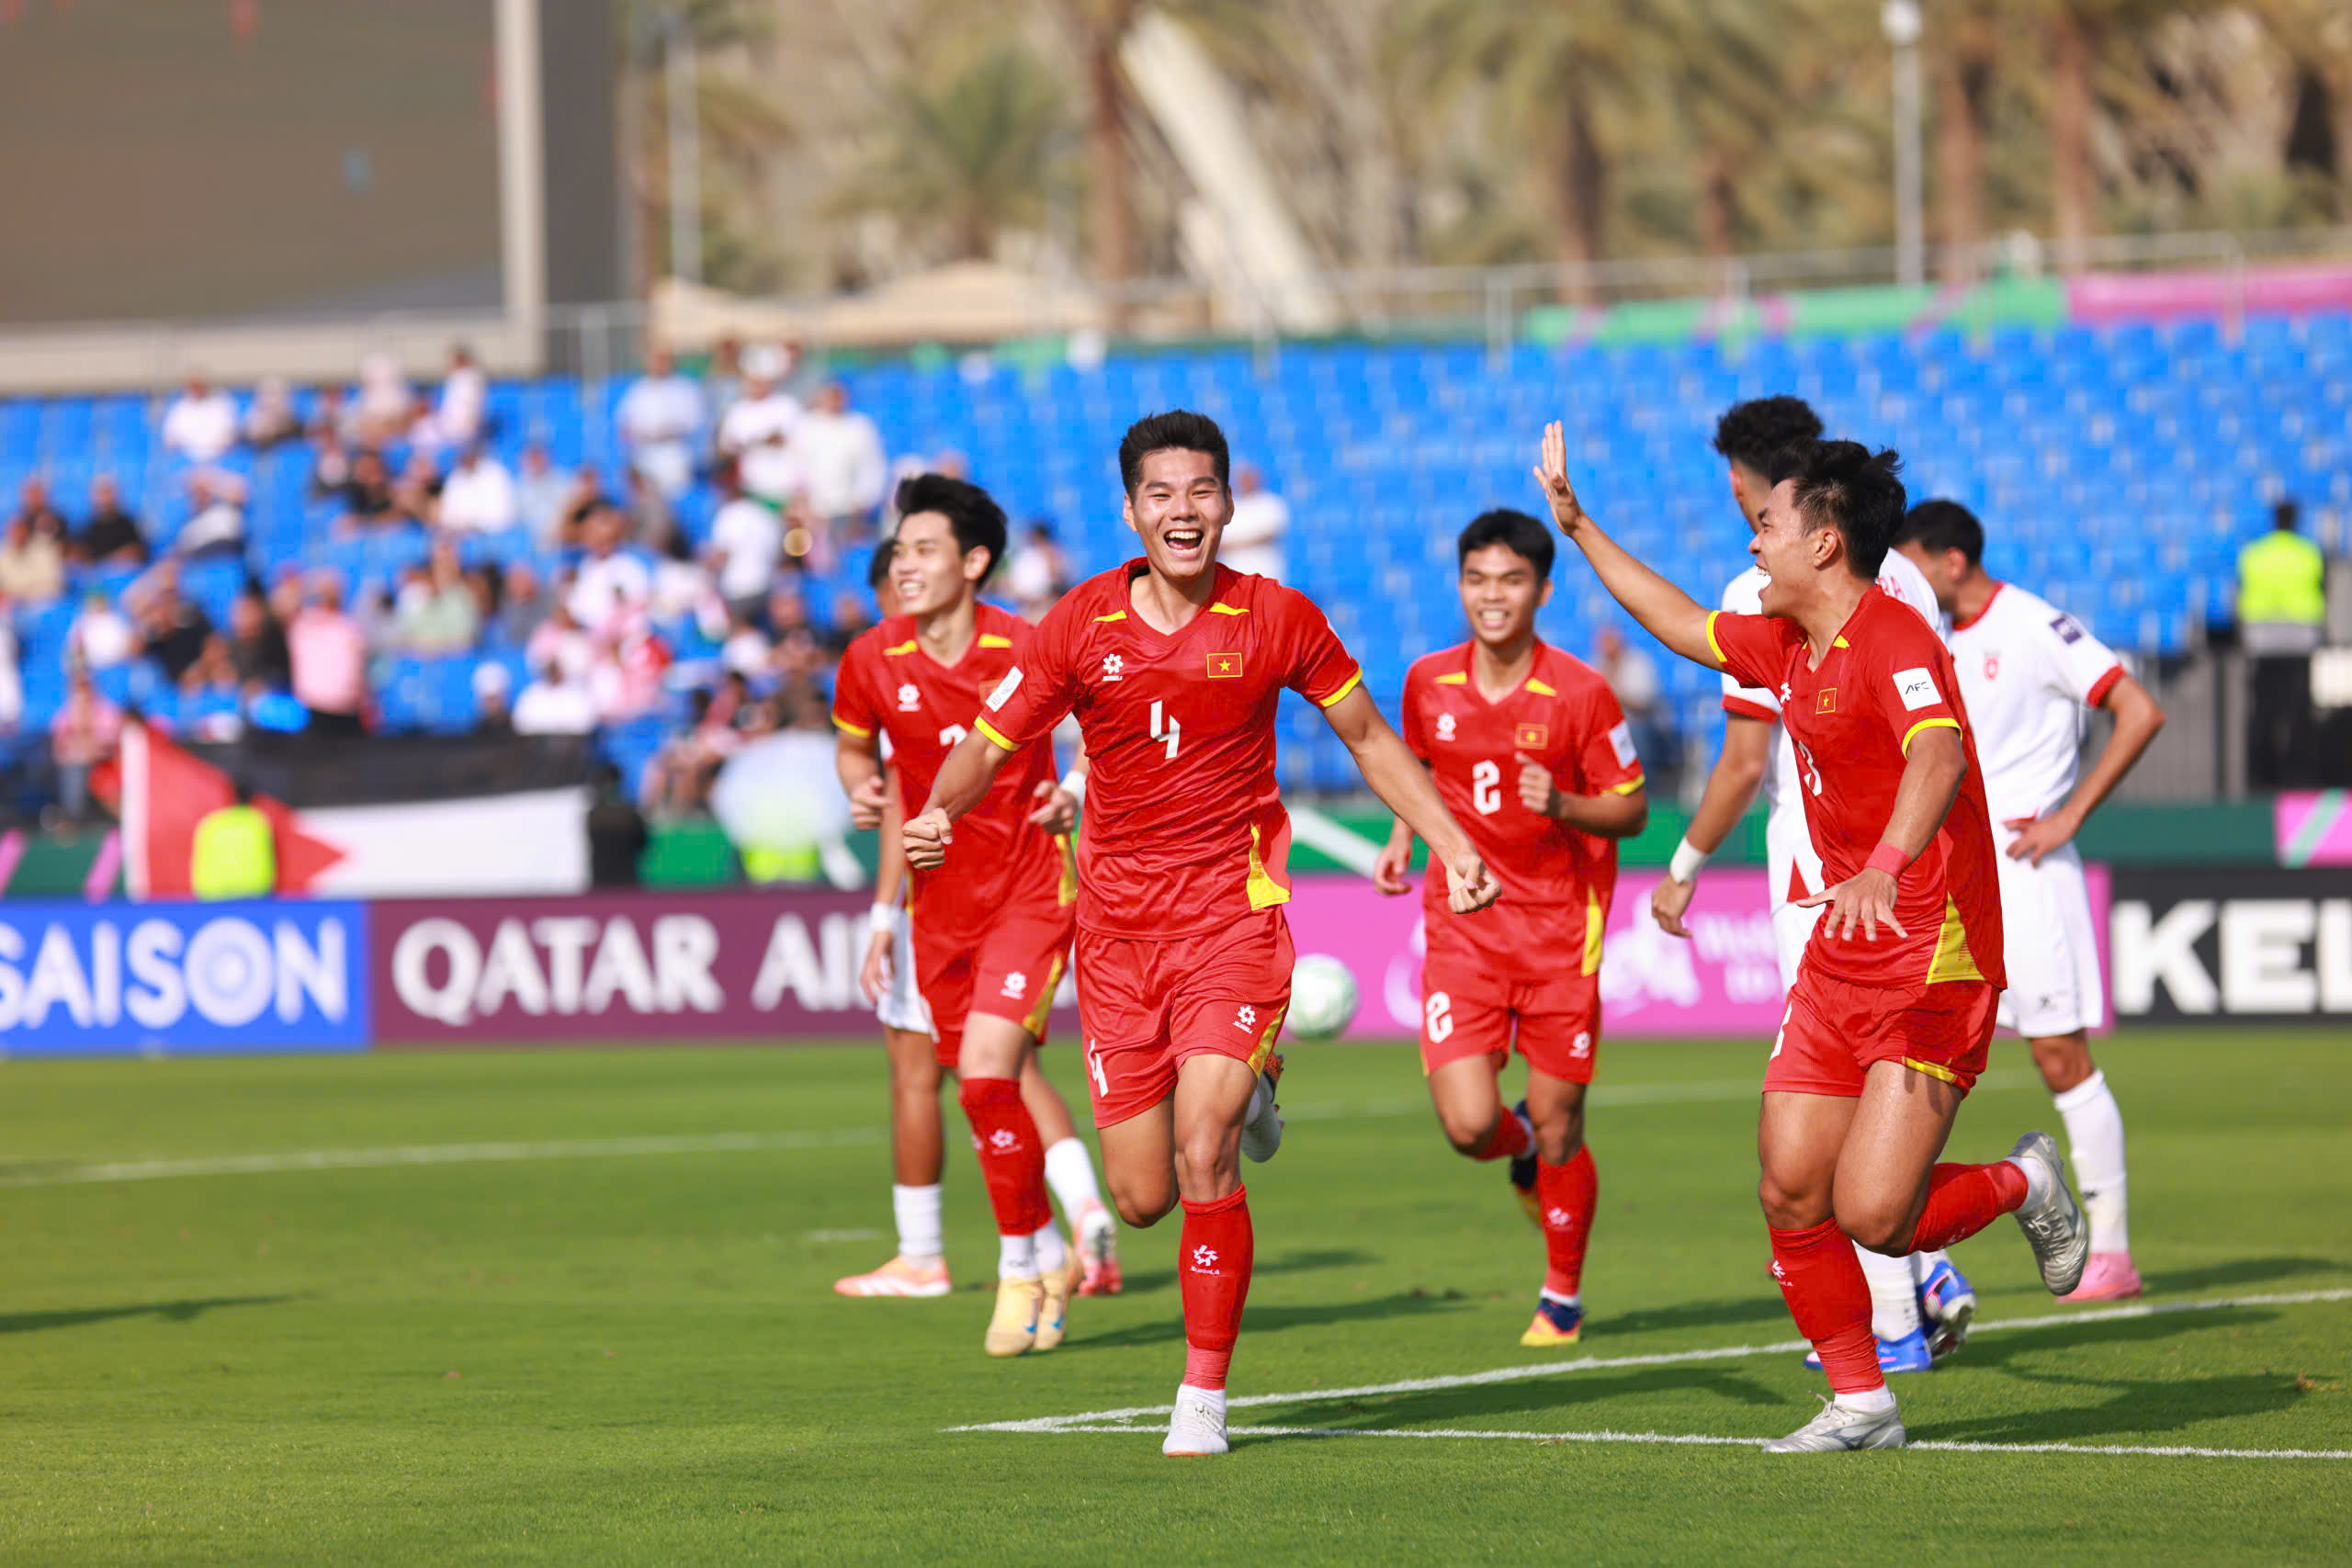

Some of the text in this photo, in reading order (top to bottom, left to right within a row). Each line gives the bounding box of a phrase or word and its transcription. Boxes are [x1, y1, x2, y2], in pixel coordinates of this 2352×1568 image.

[1905, 680, 1930, 695] AFC
[1149, 698, 1182, 760] 4
[1471, 759, 1502, 817] 2
[392, 914, 725, 1026] QATAR
[1425, 991, 1454, 1044] 2
[1087, 1037, 1110, 1099] 4
